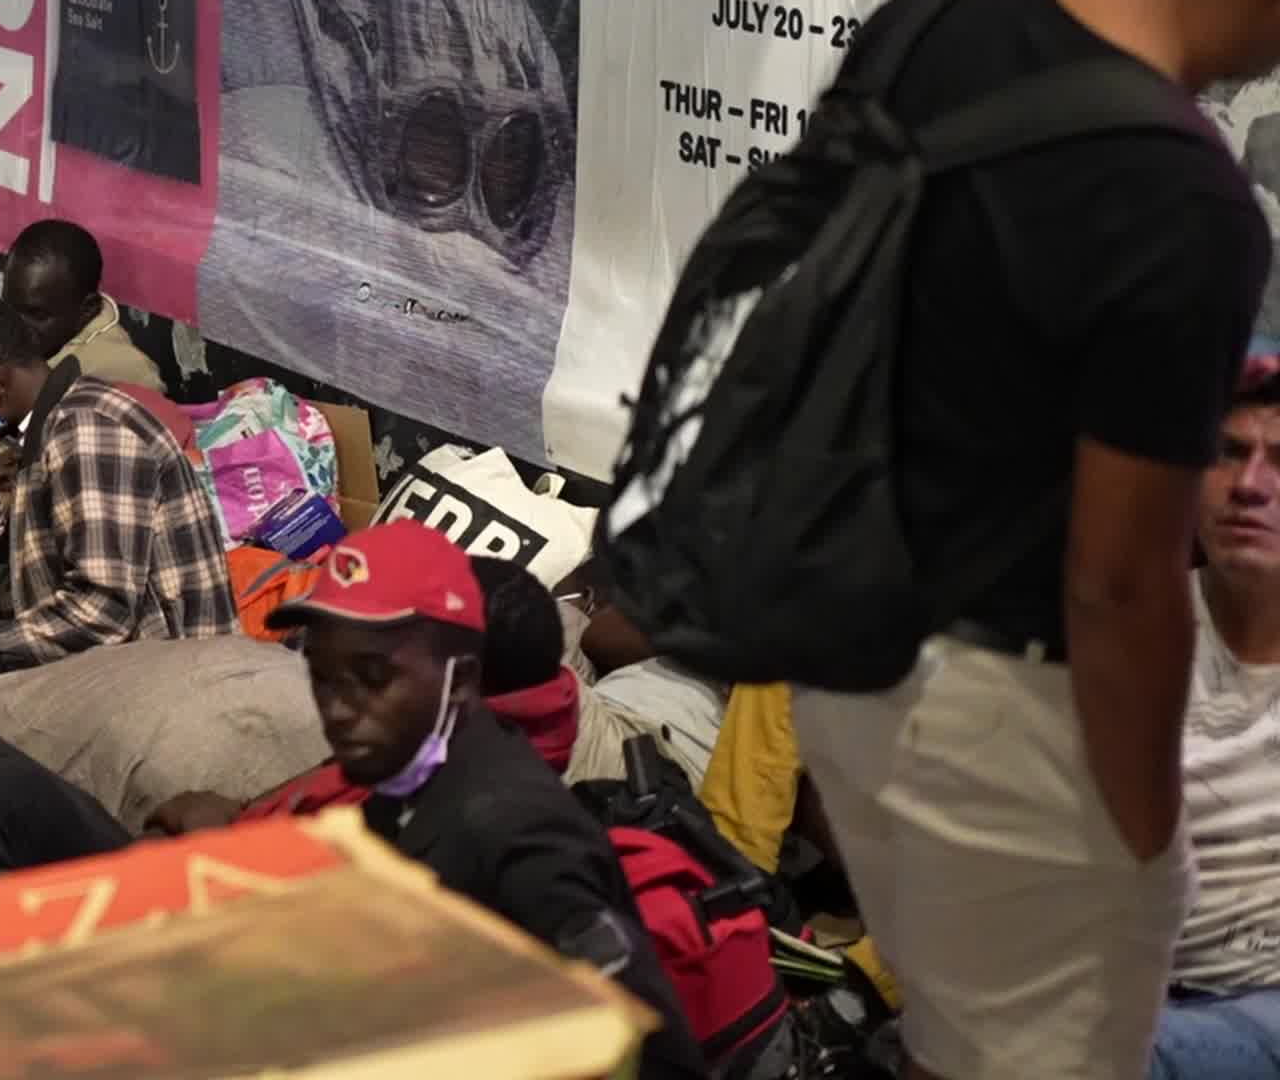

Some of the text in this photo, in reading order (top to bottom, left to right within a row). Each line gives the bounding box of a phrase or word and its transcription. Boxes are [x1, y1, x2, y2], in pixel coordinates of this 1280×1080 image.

[774, 6, 803, 40] 20
[659, 80, 722, 122] THUR
[750, 98, 787, 137] FRI
[678, 131, 721, 169] SAT
